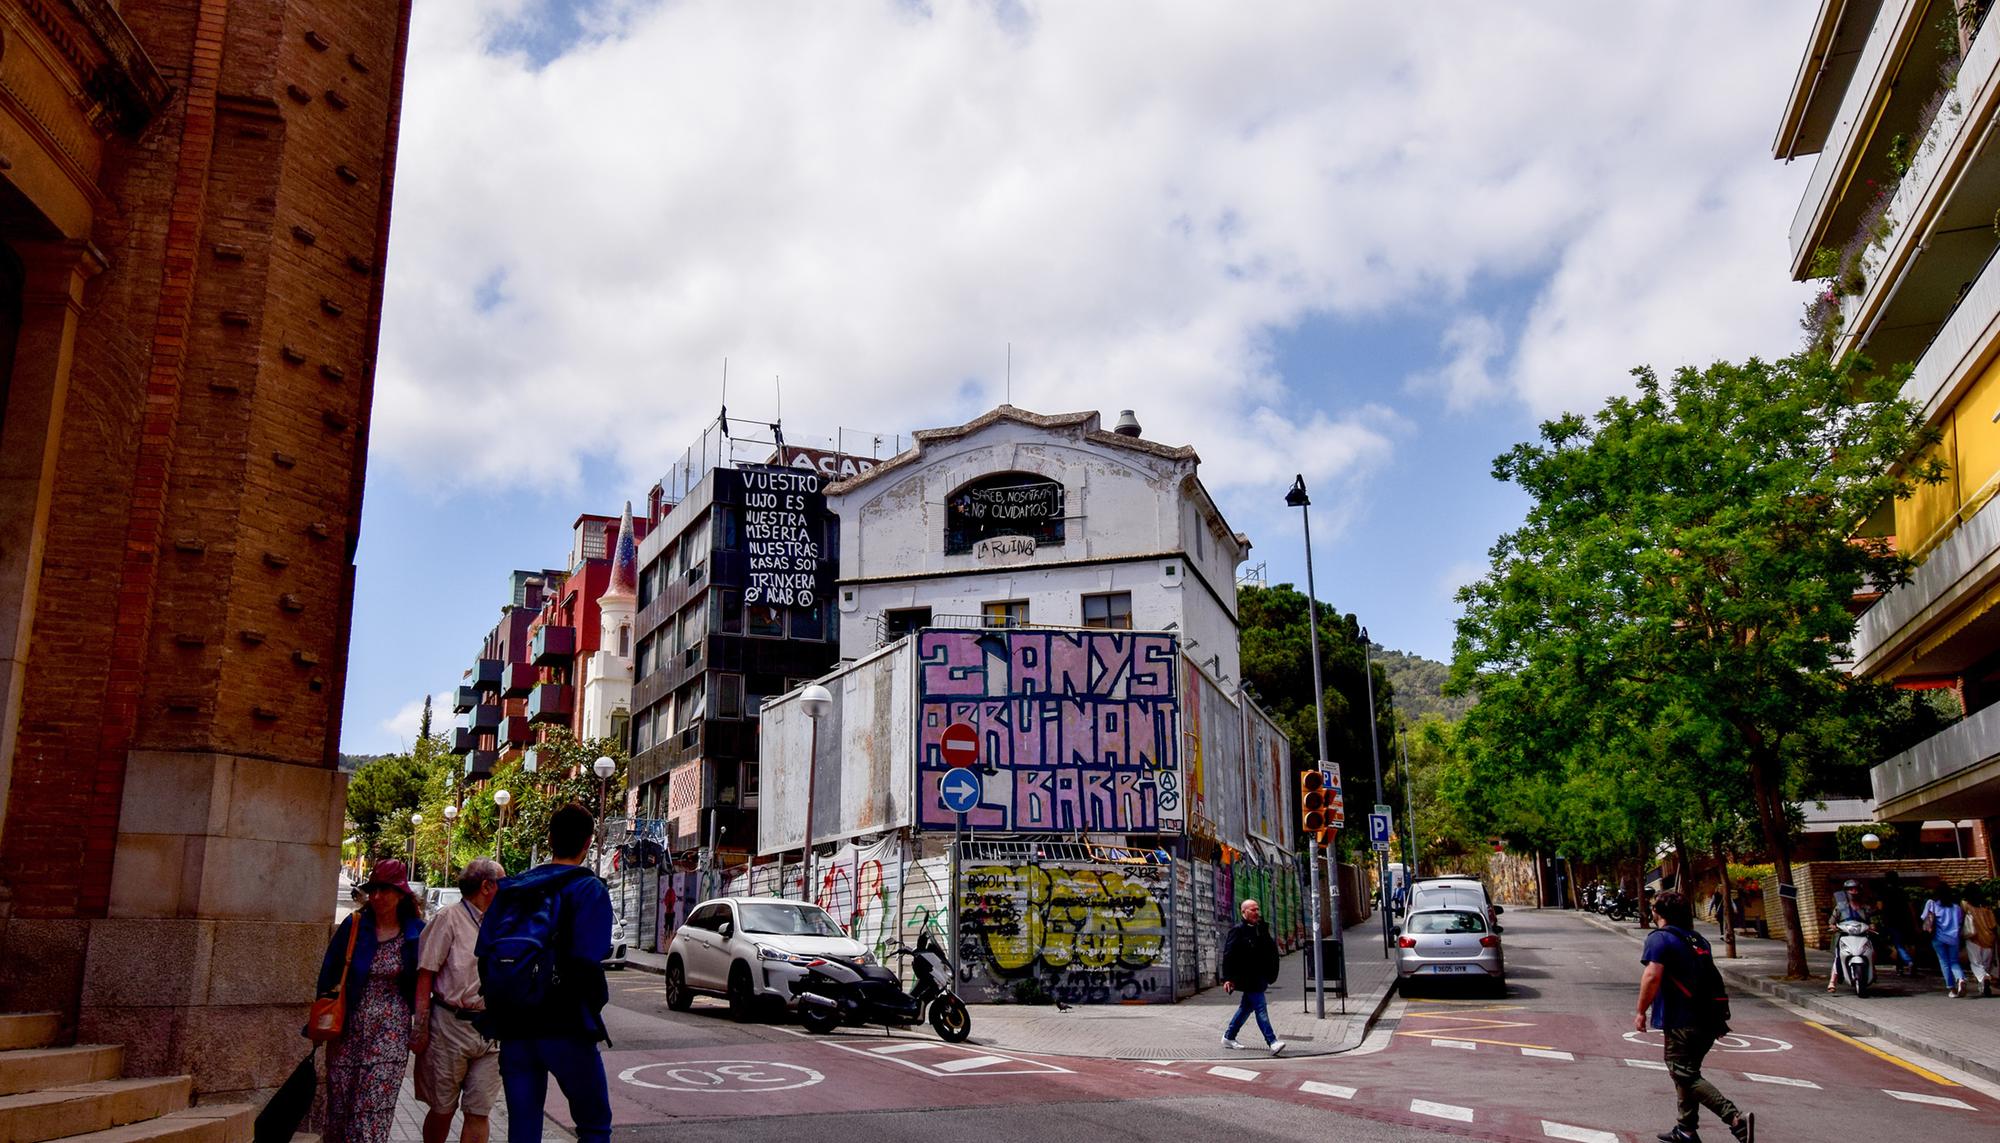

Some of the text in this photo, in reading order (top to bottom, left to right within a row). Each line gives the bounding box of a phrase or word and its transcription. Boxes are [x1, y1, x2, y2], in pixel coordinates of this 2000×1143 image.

[742, 473, 818, 493] VUESTRO
[745, 493, 805, 511] LUJO ES
[746, 512, 808, 527] NUESTRA
[746, 525, 810, 542] MISERIA
[749, 541, 818, 560] NUESTRAS
[977, 542, 990, 560] LA
[750, 557, 789, 570] KASAS
[749, 573, 816, 589] TRINXERA
[766, 587, 794, 606] ACAB
[1008, 631, 1177, 698] ANYS
[1373, 817, 1385, 839] P
